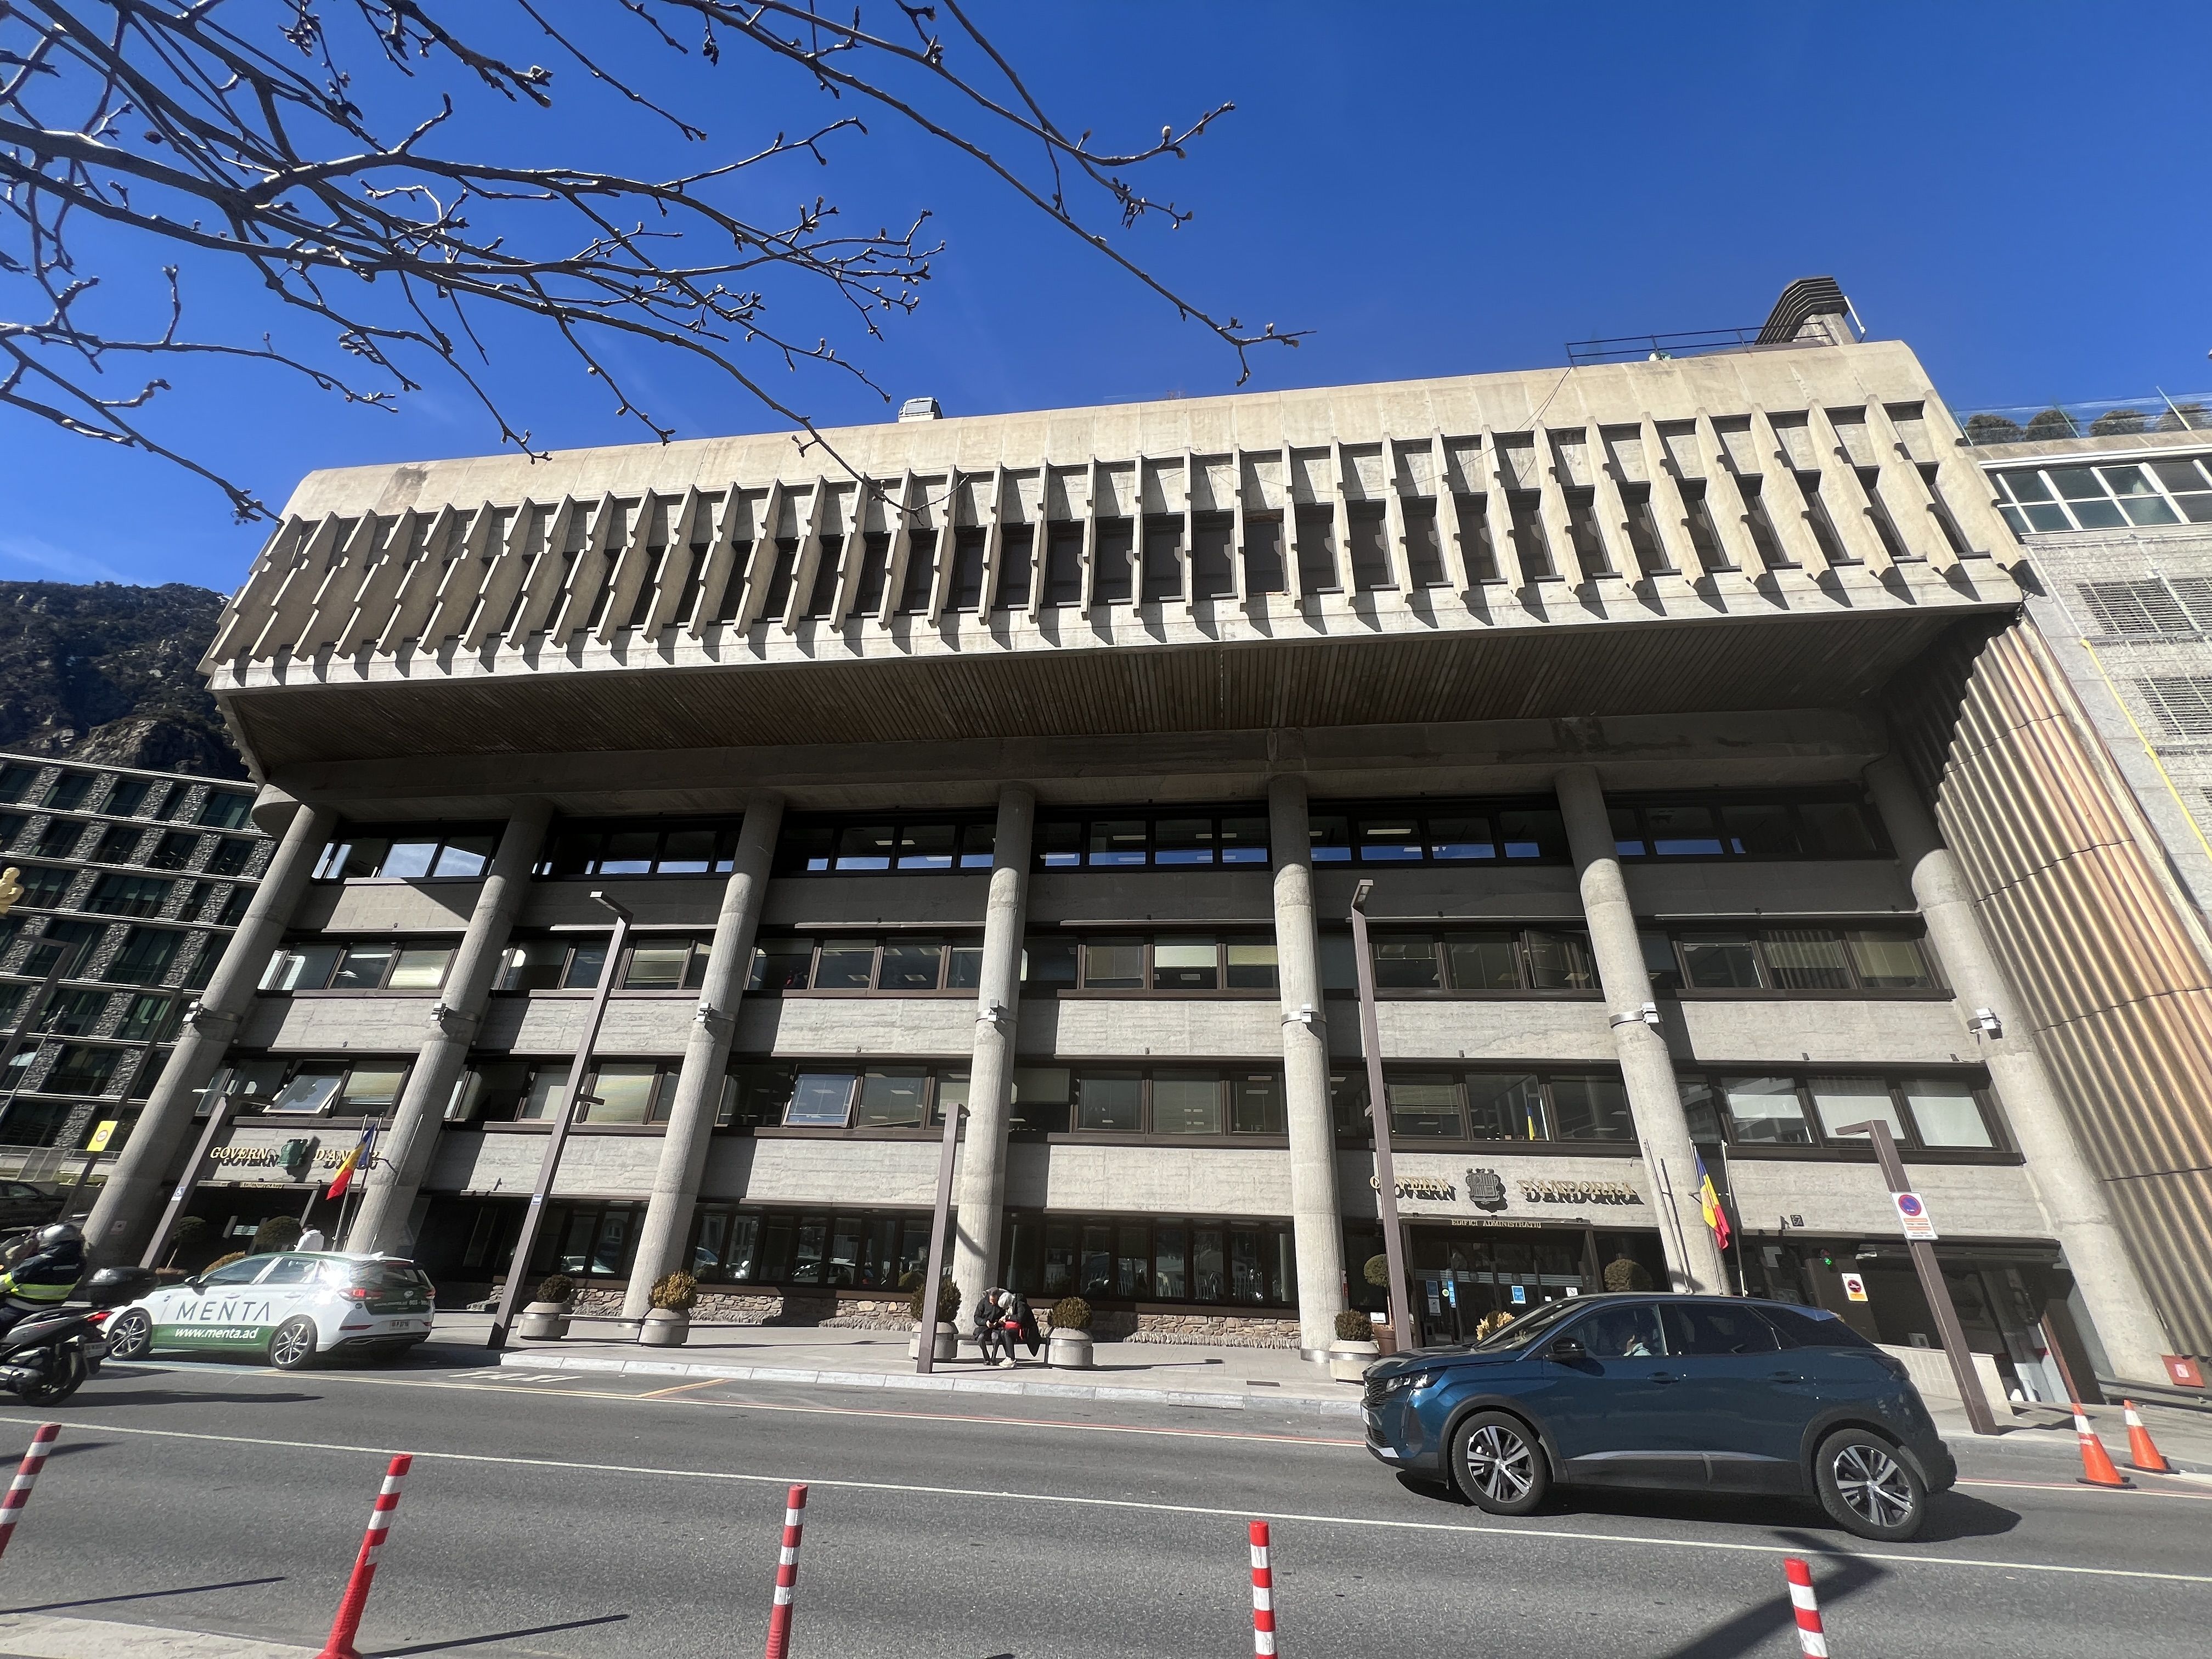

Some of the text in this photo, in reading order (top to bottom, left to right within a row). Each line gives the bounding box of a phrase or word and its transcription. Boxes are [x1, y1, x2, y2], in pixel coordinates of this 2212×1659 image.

[210, 1147, 269, 1159] GOVERN
[1370, 1175, 1637, 1195] GVERN D'ANDORRA
[1482, 1220, 1542, 1228] ADMINISTRATIU
[176, 1301, 270, 1321] MENTA
[175, 1327, 259, 1339] www.menta.ad
